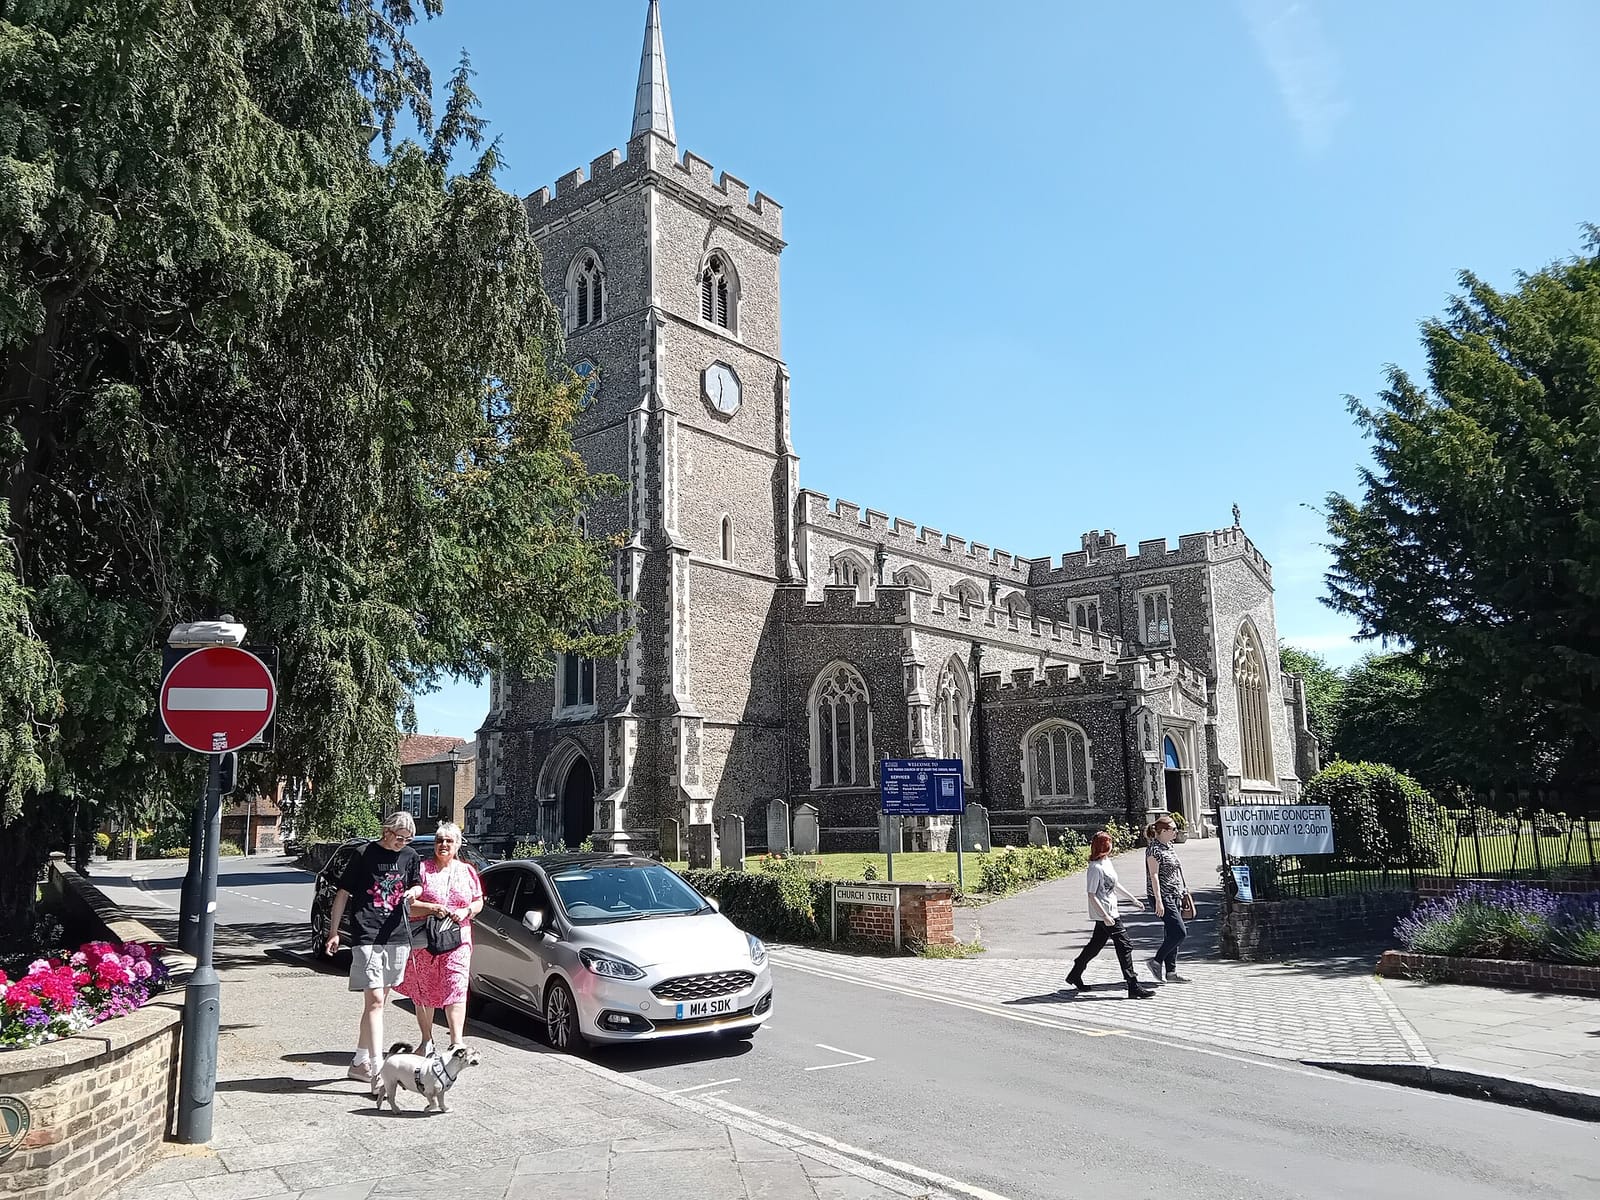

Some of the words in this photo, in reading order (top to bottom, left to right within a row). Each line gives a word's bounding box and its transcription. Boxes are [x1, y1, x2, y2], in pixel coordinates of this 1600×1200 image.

[1224, 809, 1280, 822] LUNCHTIME
[1281, 809, 1326, 821] CONCERT
[1226, 825, 1249, 837] THIS
[1250, 824, 1290, 836] MONDAY
[1292, 823, 1328, 837] 12.30pm
[377, 863, 399, 872] NIRV
[836, 889, 865, 900] CHURCH
[867, 891, 892, 902] STREET
[690, 1002, 707, 1016] M14
[710, 998, 732, 1013] SDK
